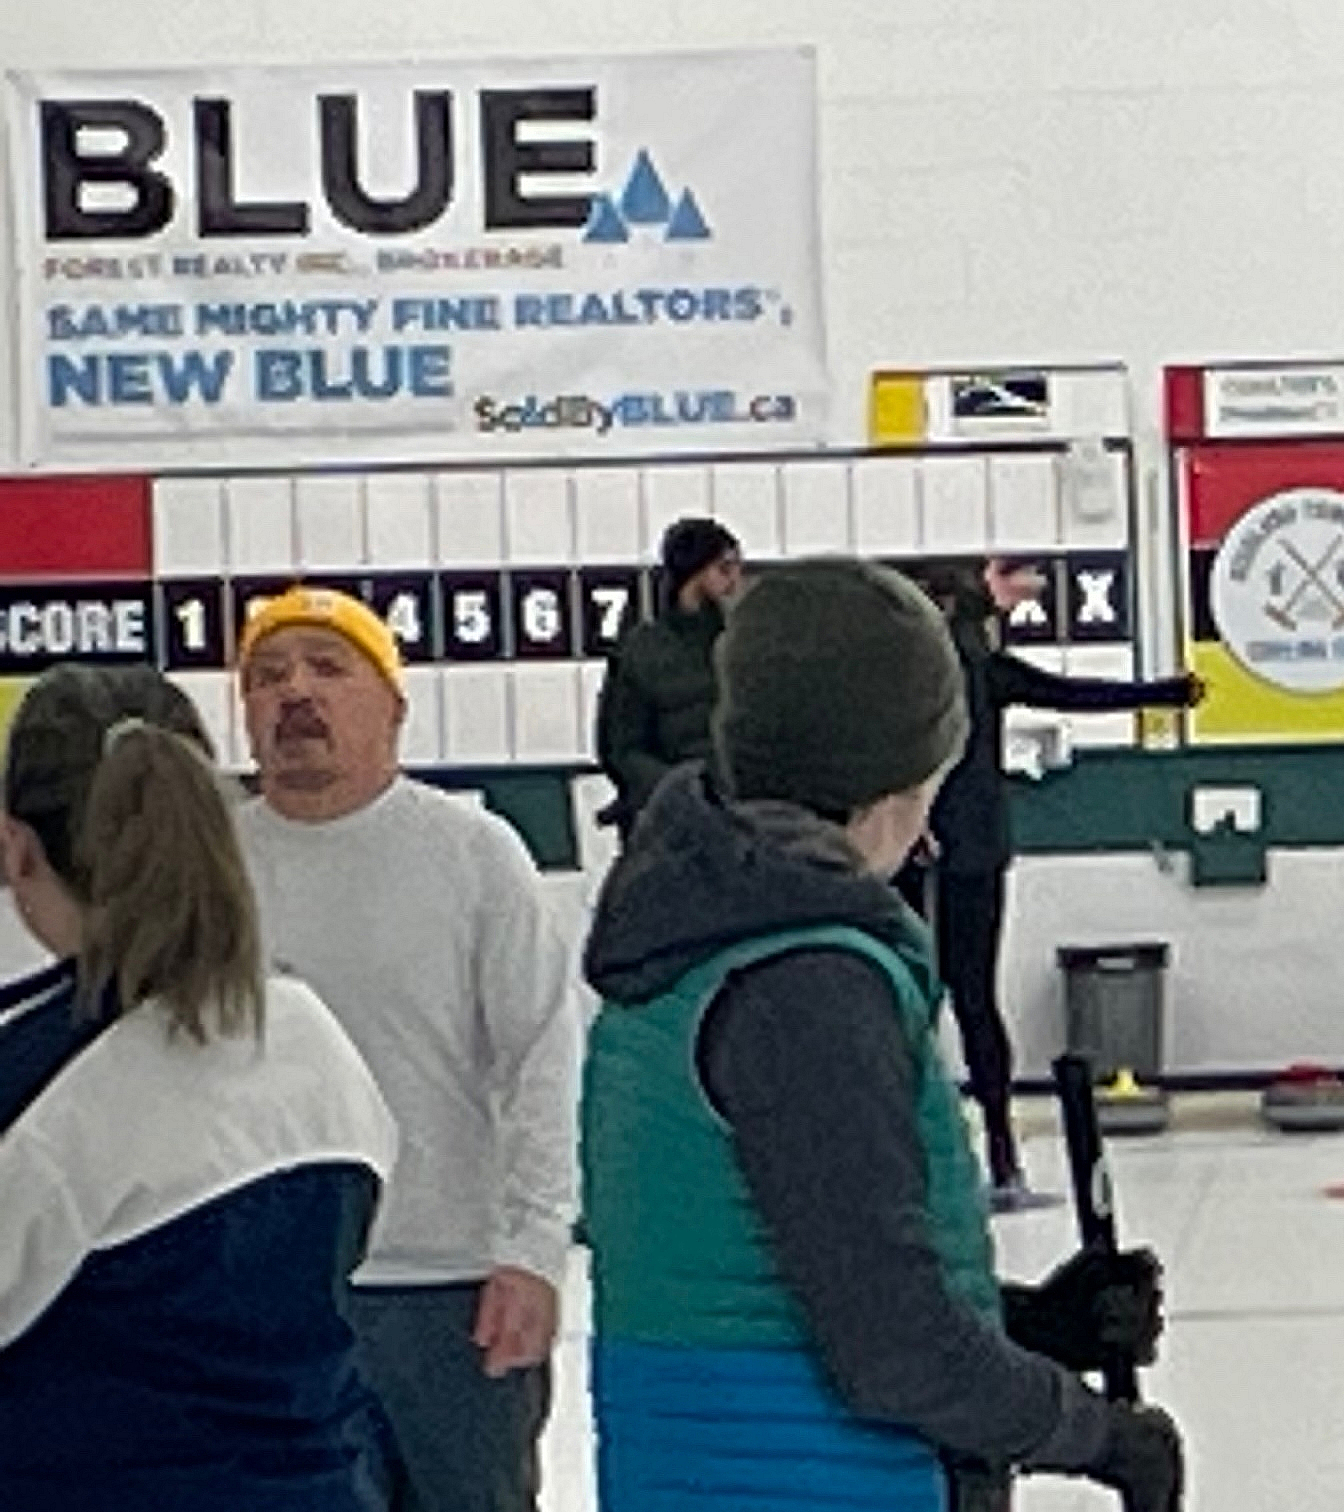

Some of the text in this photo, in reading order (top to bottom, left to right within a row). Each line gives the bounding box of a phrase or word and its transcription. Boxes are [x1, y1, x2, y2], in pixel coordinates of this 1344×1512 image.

[38, 85, 598, 240] BLUE
[46, 304, 184, 340] SAME
[195, 299, 378, 335] MIGHTY
[392, 297, 501, 332] FINE
[48, 346, 454, 406] NEW BLUE
[177, 599, 205, 649] 1
[386, 592, 422, 643] 4
[454, 591, 491, 642] 5
[523, 589, 560, 641] 6
[591, 588, 629, 638] 7
[1076, 571, 1115, 623] X
